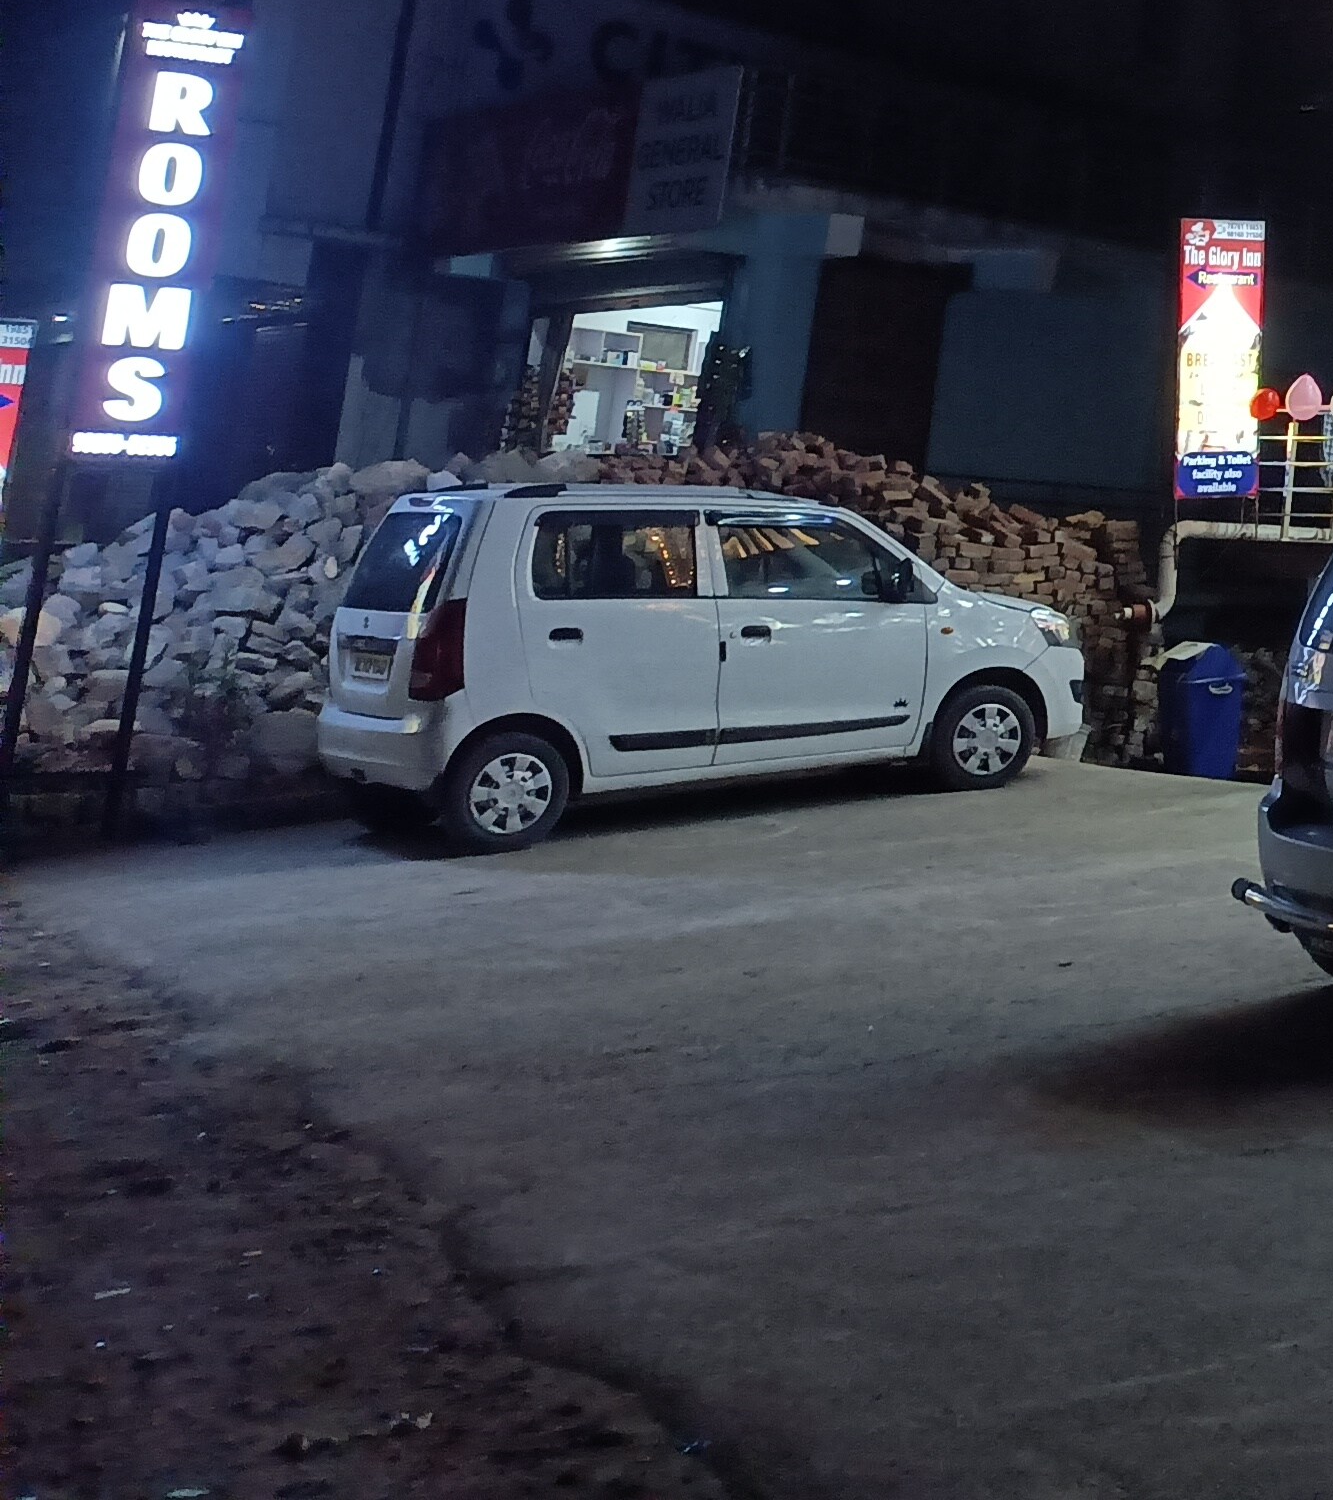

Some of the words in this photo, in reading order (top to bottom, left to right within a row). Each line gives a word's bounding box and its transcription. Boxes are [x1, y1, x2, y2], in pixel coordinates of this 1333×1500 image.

[637, 134, 724, 171] GENERAL
[645, 176, 708, 211] STORE
[101, 70, 215, 422] ROOMS
[1183, 245, 1206, 266] The
[1208, 246, 1241, 271] Glory
[1242, 248, 1262, 268] Inn
[1198, 271, 1255, 286] Rerant
[1187, 352, 1253, 368] BREST
[0, 362, 26, 385] nn
[1183, 455, 1217, 467] Parking
[1218, 455, 1226, 464] &
[1226, 454, 1252, 465] Toilet
[1192, 468, 1223, 480] facility
[1224, 468, 1242, 479] also
[1197, 482, 1237, 492] available
